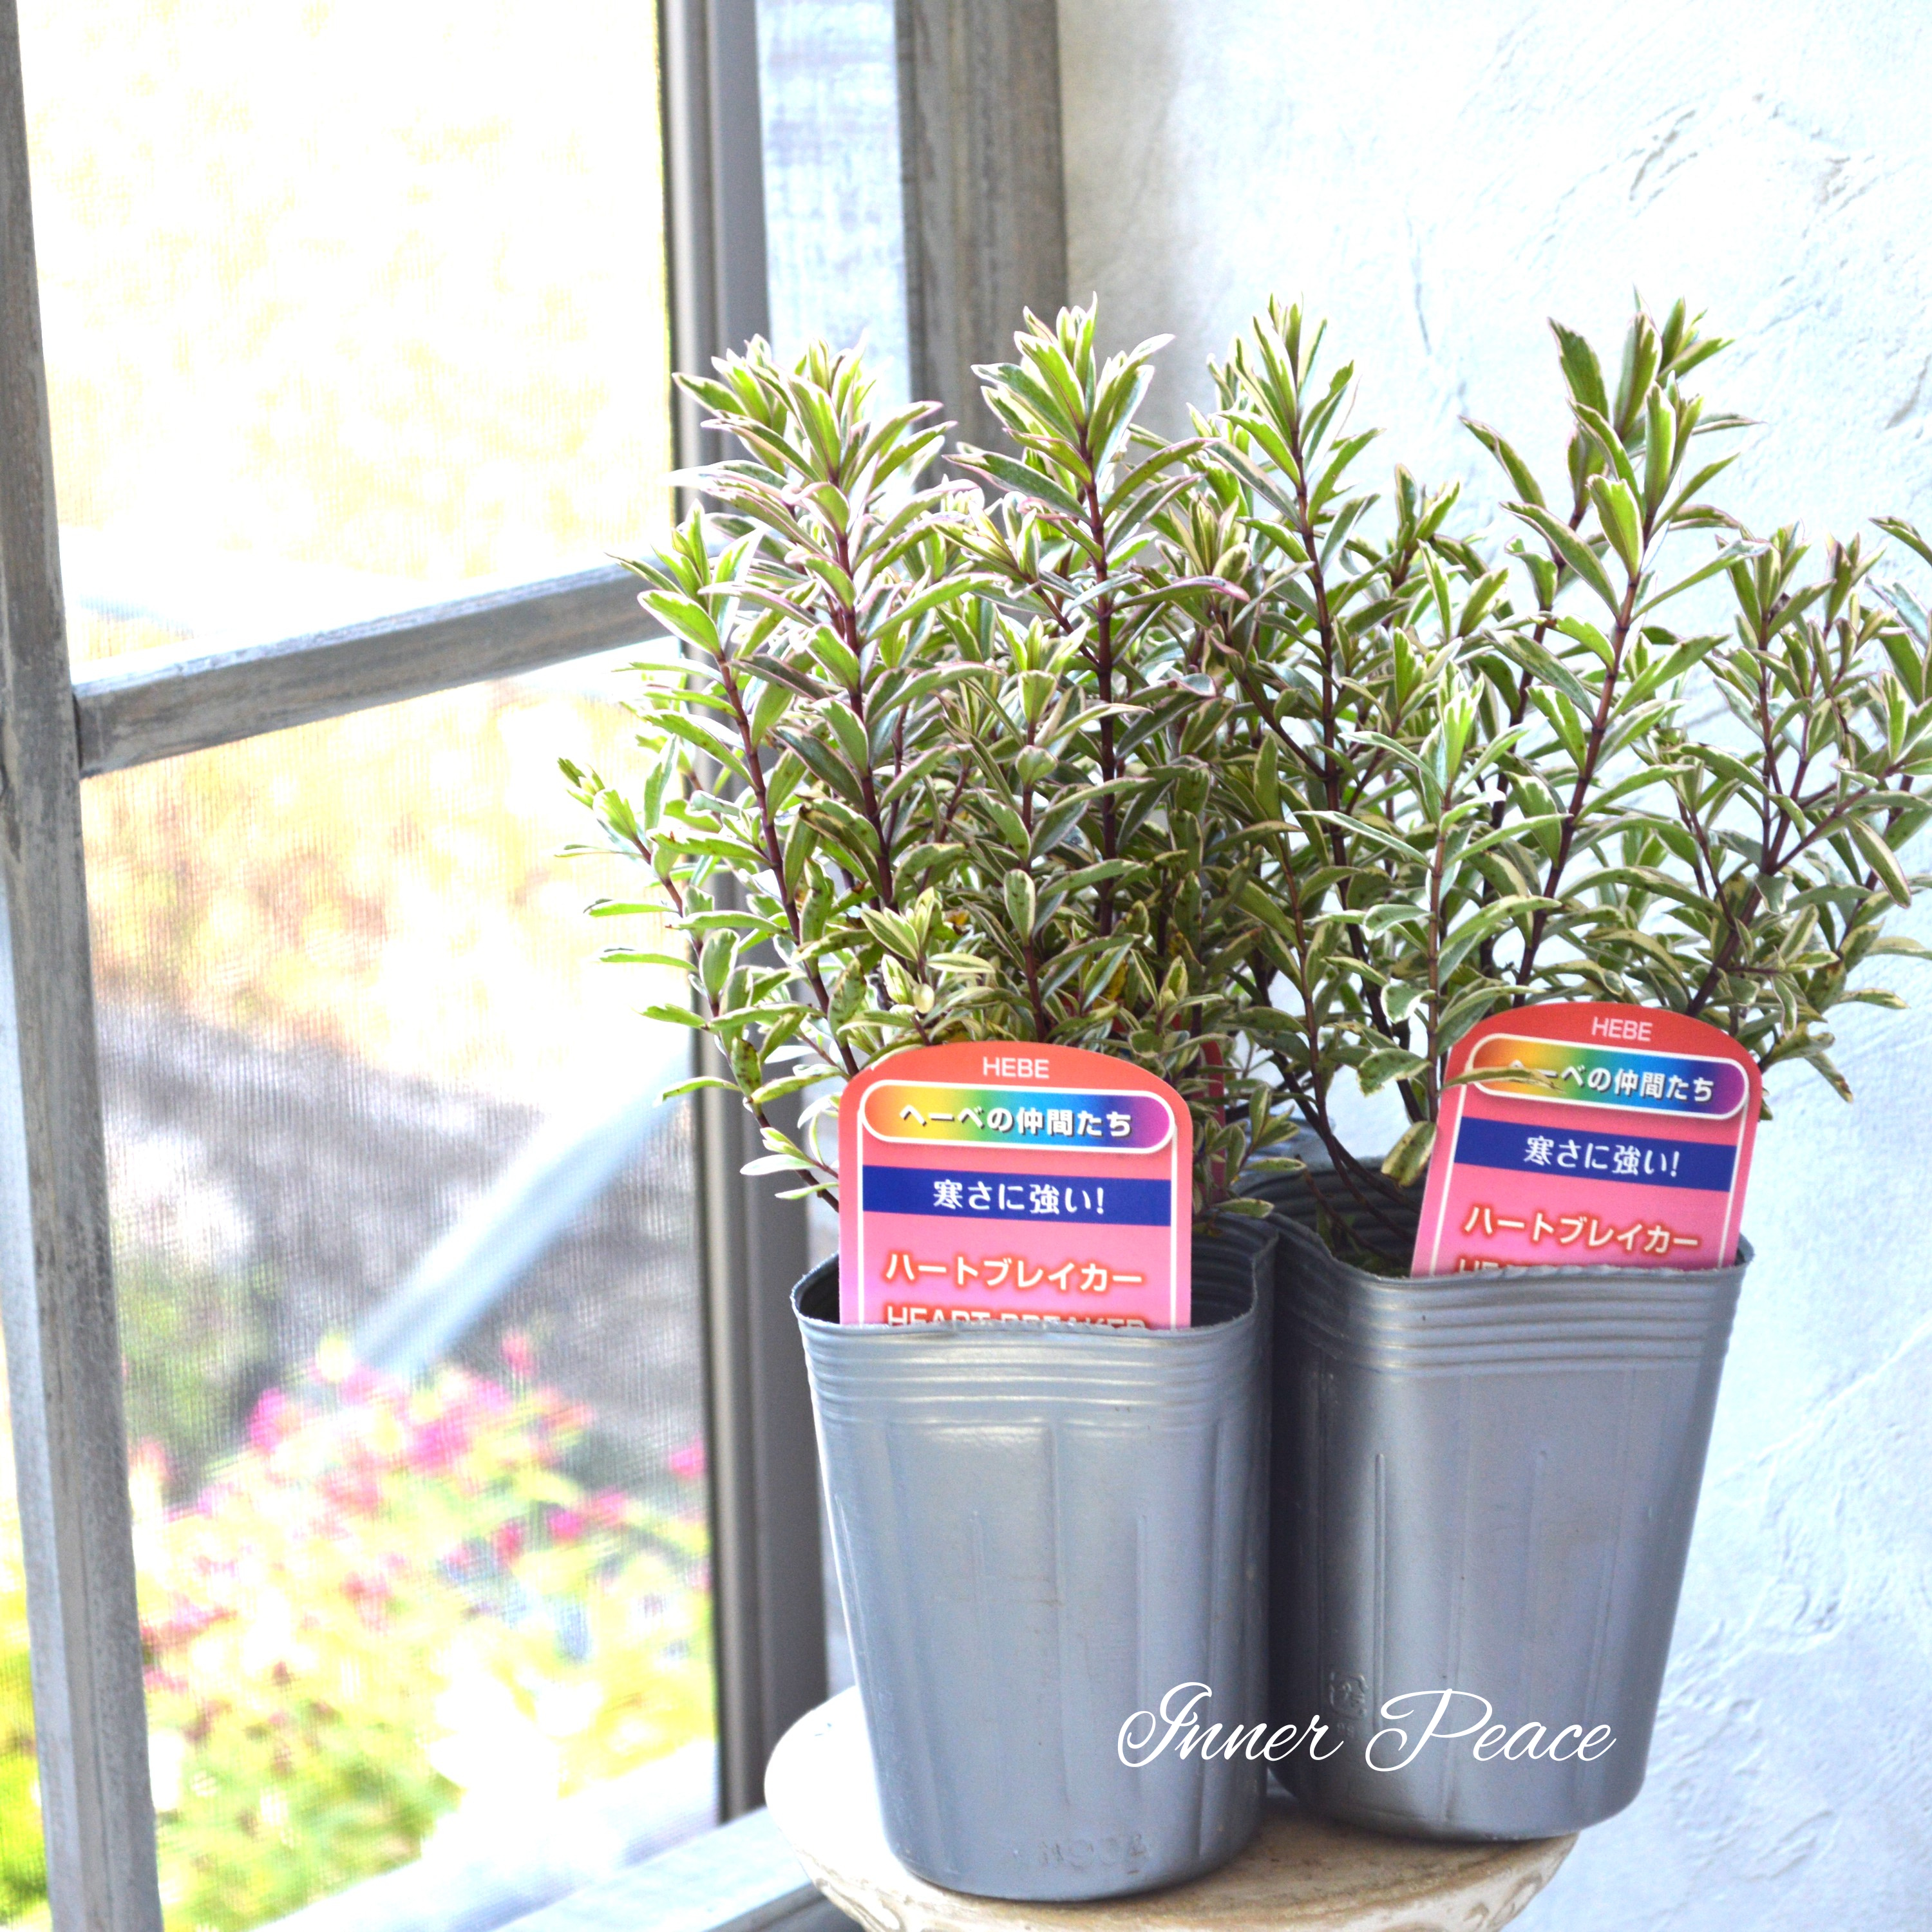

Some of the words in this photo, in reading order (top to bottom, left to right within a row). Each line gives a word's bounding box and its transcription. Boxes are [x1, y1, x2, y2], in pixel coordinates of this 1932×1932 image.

[1591, 1017, 1653, 1041] HEBE
[983, 1057, 1050, 1079] HEBE
[1508, 1060, 1714, 1102] ーベの仲間たち
[1465, 1207, 1698, 1253] ハートブレイカー
[886, 1254, 1142, 1292] ハートブレイカー
